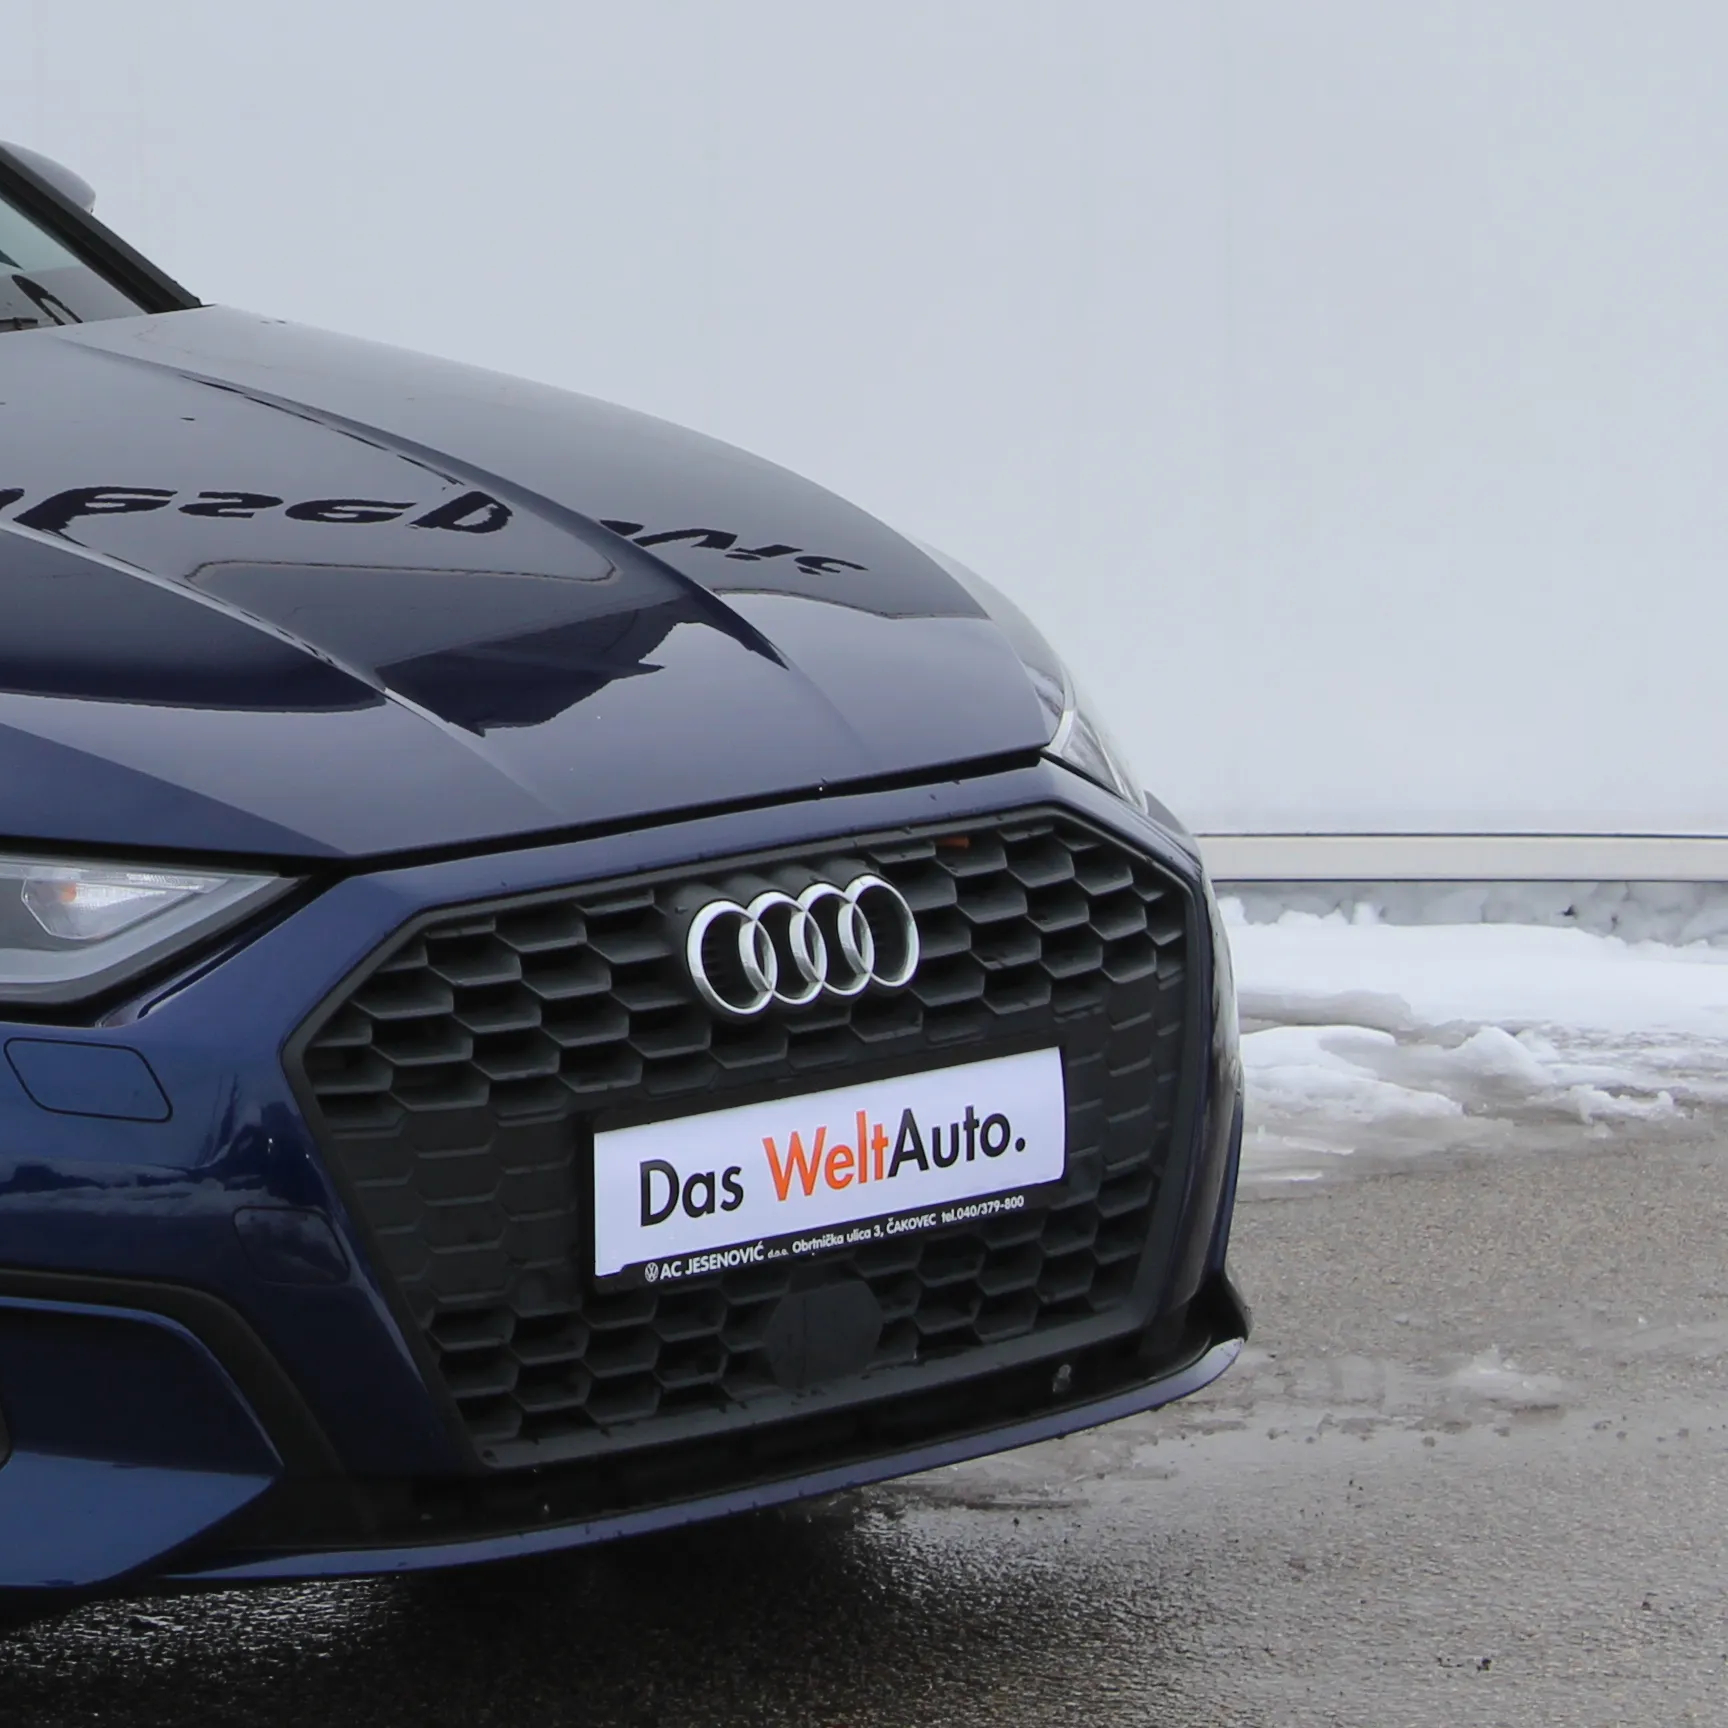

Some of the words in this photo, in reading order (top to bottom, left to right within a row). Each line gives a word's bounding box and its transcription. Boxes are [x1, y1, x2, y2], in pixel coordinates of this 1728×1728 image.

[640, 1159, 744, 1227] Das
[761, 1104, 1026, 1201] WeltAuto.
[660, 1261, 682, 1280] AC
[685, 1240, 764, 1275] JESENOVIĆ
[792, 1233, 844, 1253] Obrtnička
[846, 1228, 871, 1243] ulica
[886, 1213, 937, 1234] ČAKOVEC
